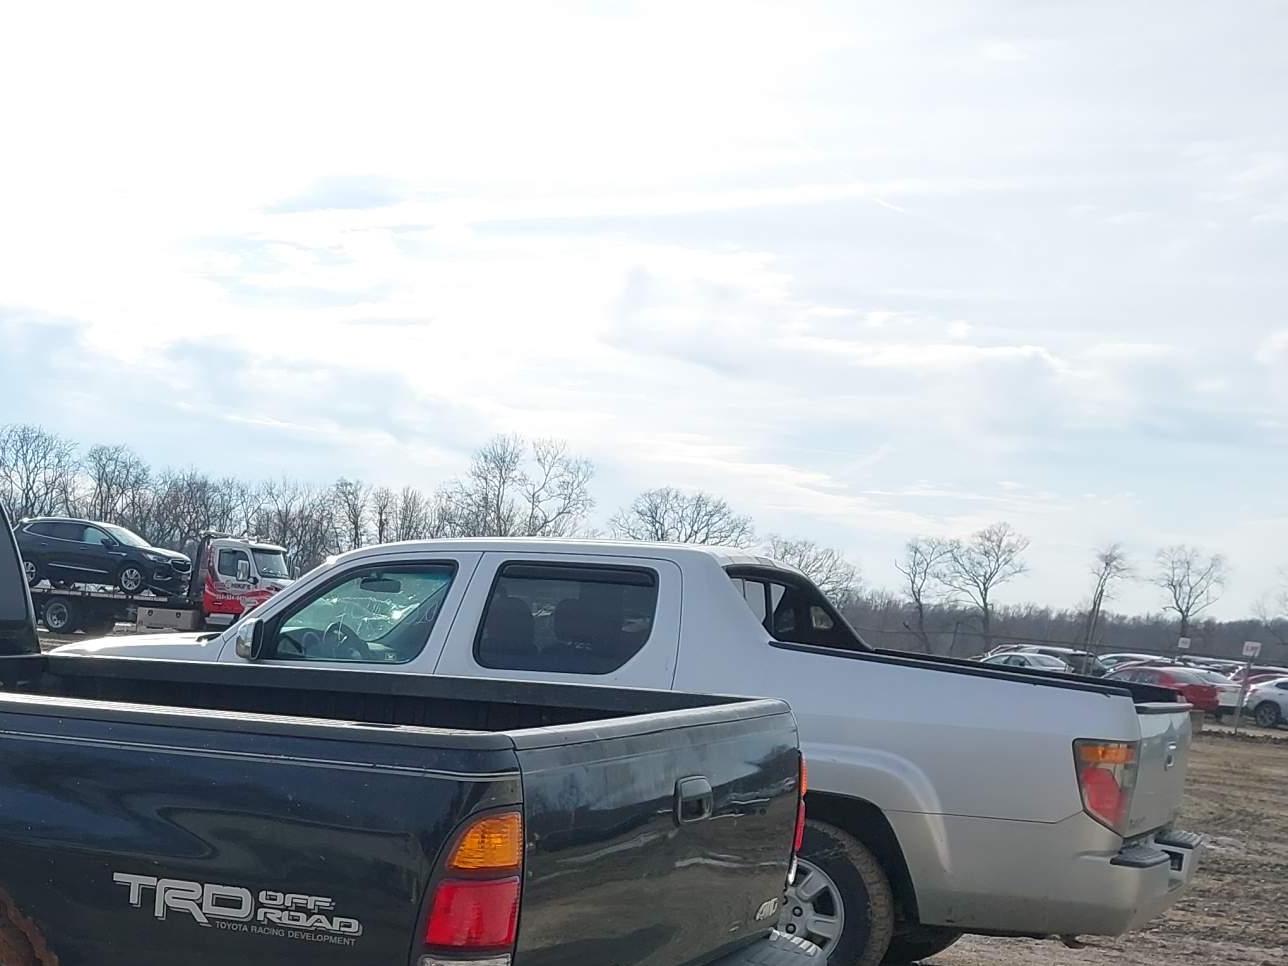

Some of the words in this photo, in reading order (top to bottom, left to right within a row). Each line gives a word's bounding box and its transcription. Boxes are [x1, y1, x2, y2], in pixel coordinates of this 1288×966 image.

[113, 872, 254, 927] TRD
[258, 890, 336, 912] OFF
[215, 921, 249, 933] TOYOTA
[250, 924, 285, 938] RACING
[287, 930, 357, 947] DEVELOPMENT
[257, 908, 362, 936] ROAD
